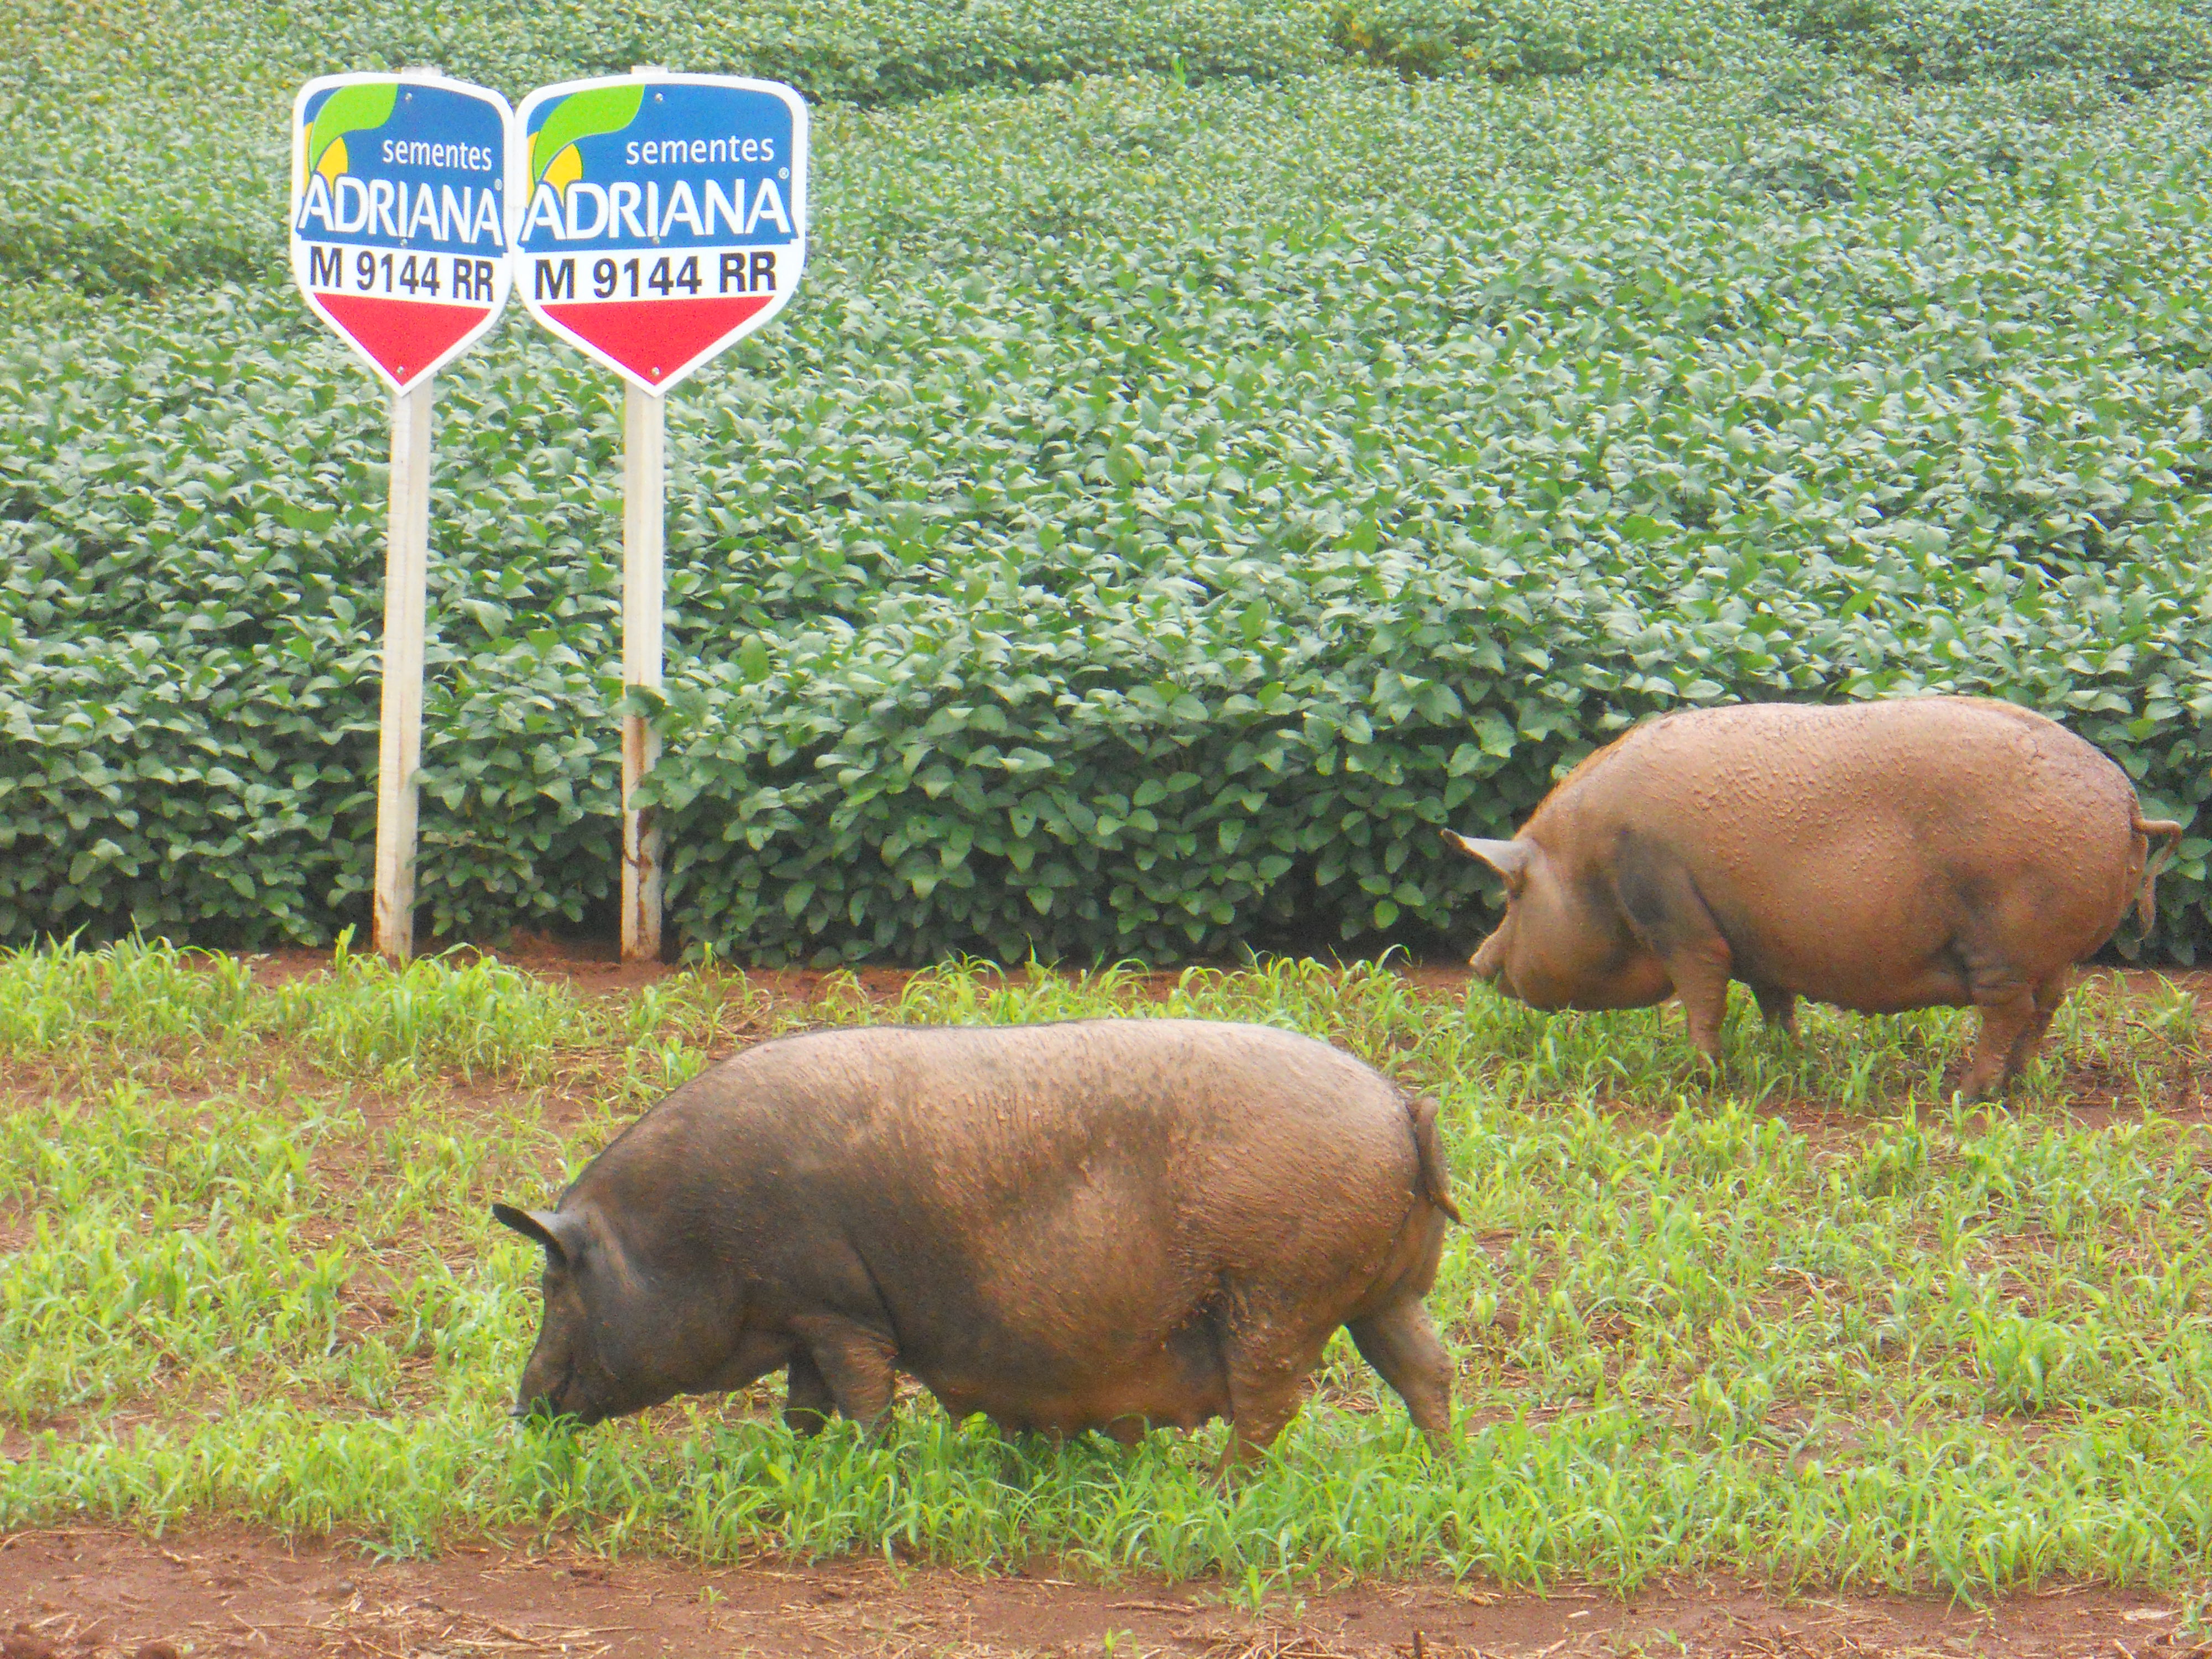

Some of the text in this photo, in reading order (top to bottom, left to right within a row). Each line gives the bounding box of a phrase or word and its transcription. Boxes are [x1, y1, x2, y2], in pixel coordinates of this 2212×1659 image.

[383, 139, 492, 171] sementes
[626, 135, 775, 165] sementes
[298, 174, 504, 247] ADRIANA
[521, 178, 792, 242] ADRIANA
[310, 246, 494, 302] M 9144 RR
[534, 251, 777, 300] M 9144 RR
